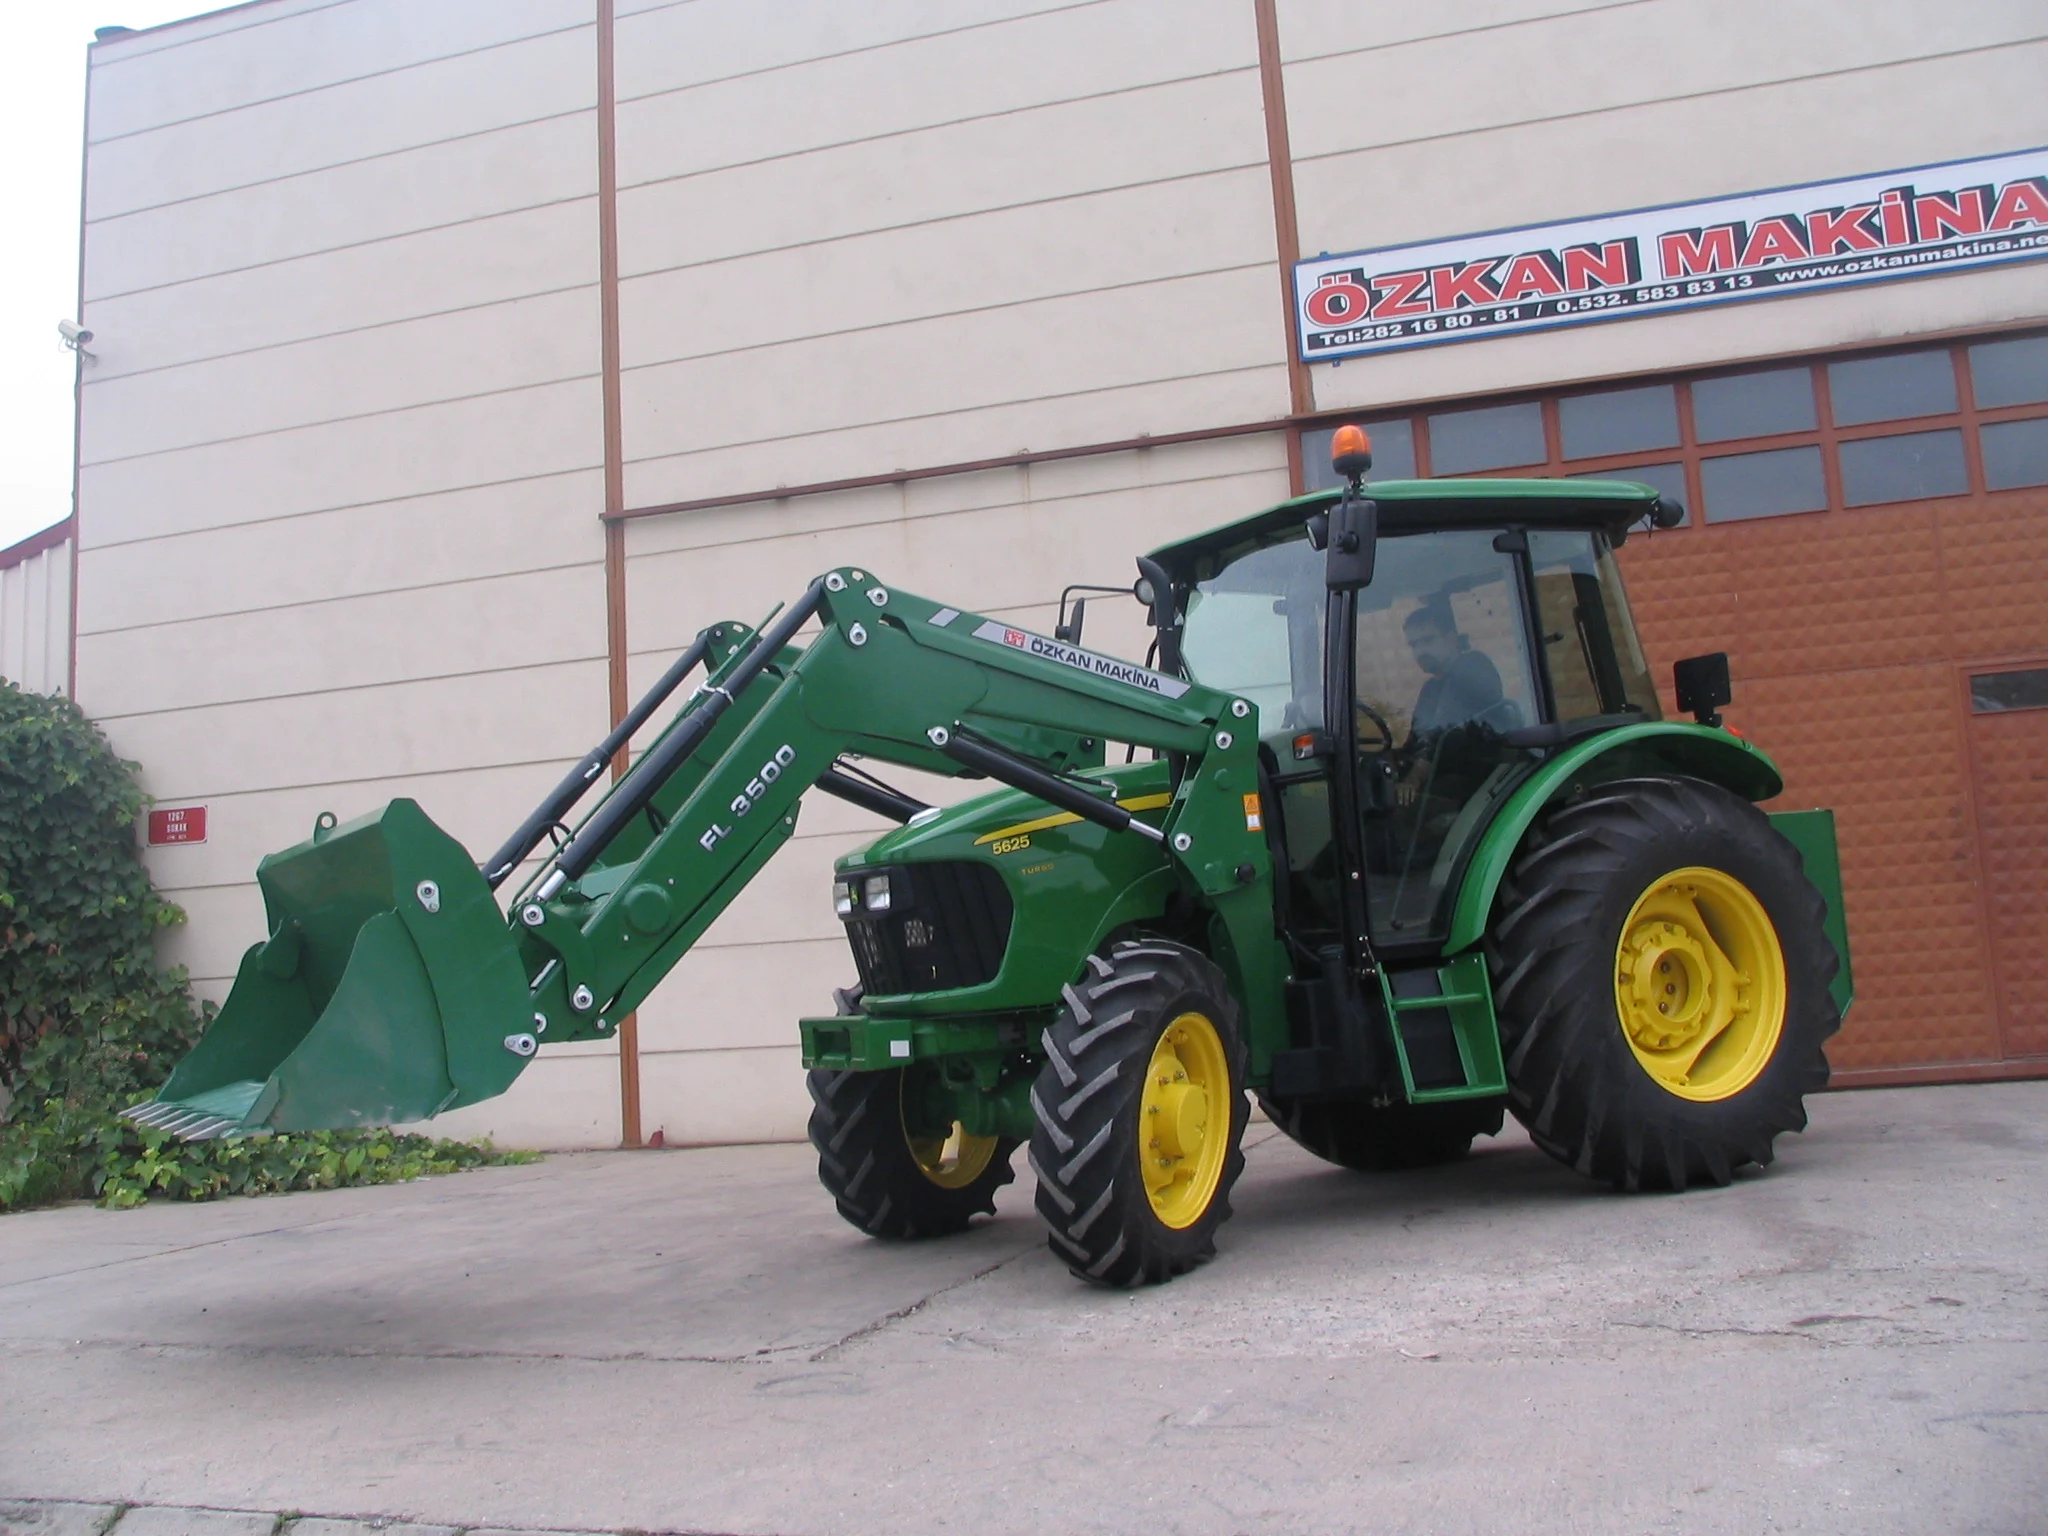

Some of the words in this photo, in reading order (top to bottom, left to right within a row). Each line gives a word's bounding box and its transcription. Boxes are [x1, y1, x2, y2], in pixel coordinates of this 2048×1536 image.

[1304, 237, 1642, 327] ÖZKAN
[1656, 175, 2048, 280] MAKİNA
[1319, 323, 1403, 346] Tel:282
[1410, 318, 1438, 333] 16
[1445, 314, 1473, 329] 80
[1494, 306, 1520, 323] 81
[1535, 304, 1543, 317] /
[1556, 293, 1629, 314] 0.532.
[1635, 285, 1680, 302] 583
[1687, 280, 1717, 296] 83
[1724, 274, 1755, 290] 13
[1031, 637, 1091, 669] ÖZKAN
[1094, 660, 1160, 692] MAKİNA
[699, 823, 733, 852] FL
[730, 744, 796, 818] 3500
[992, 834, 1031, 855] 5625
[1021, 863, 1054, 875] TURBO
